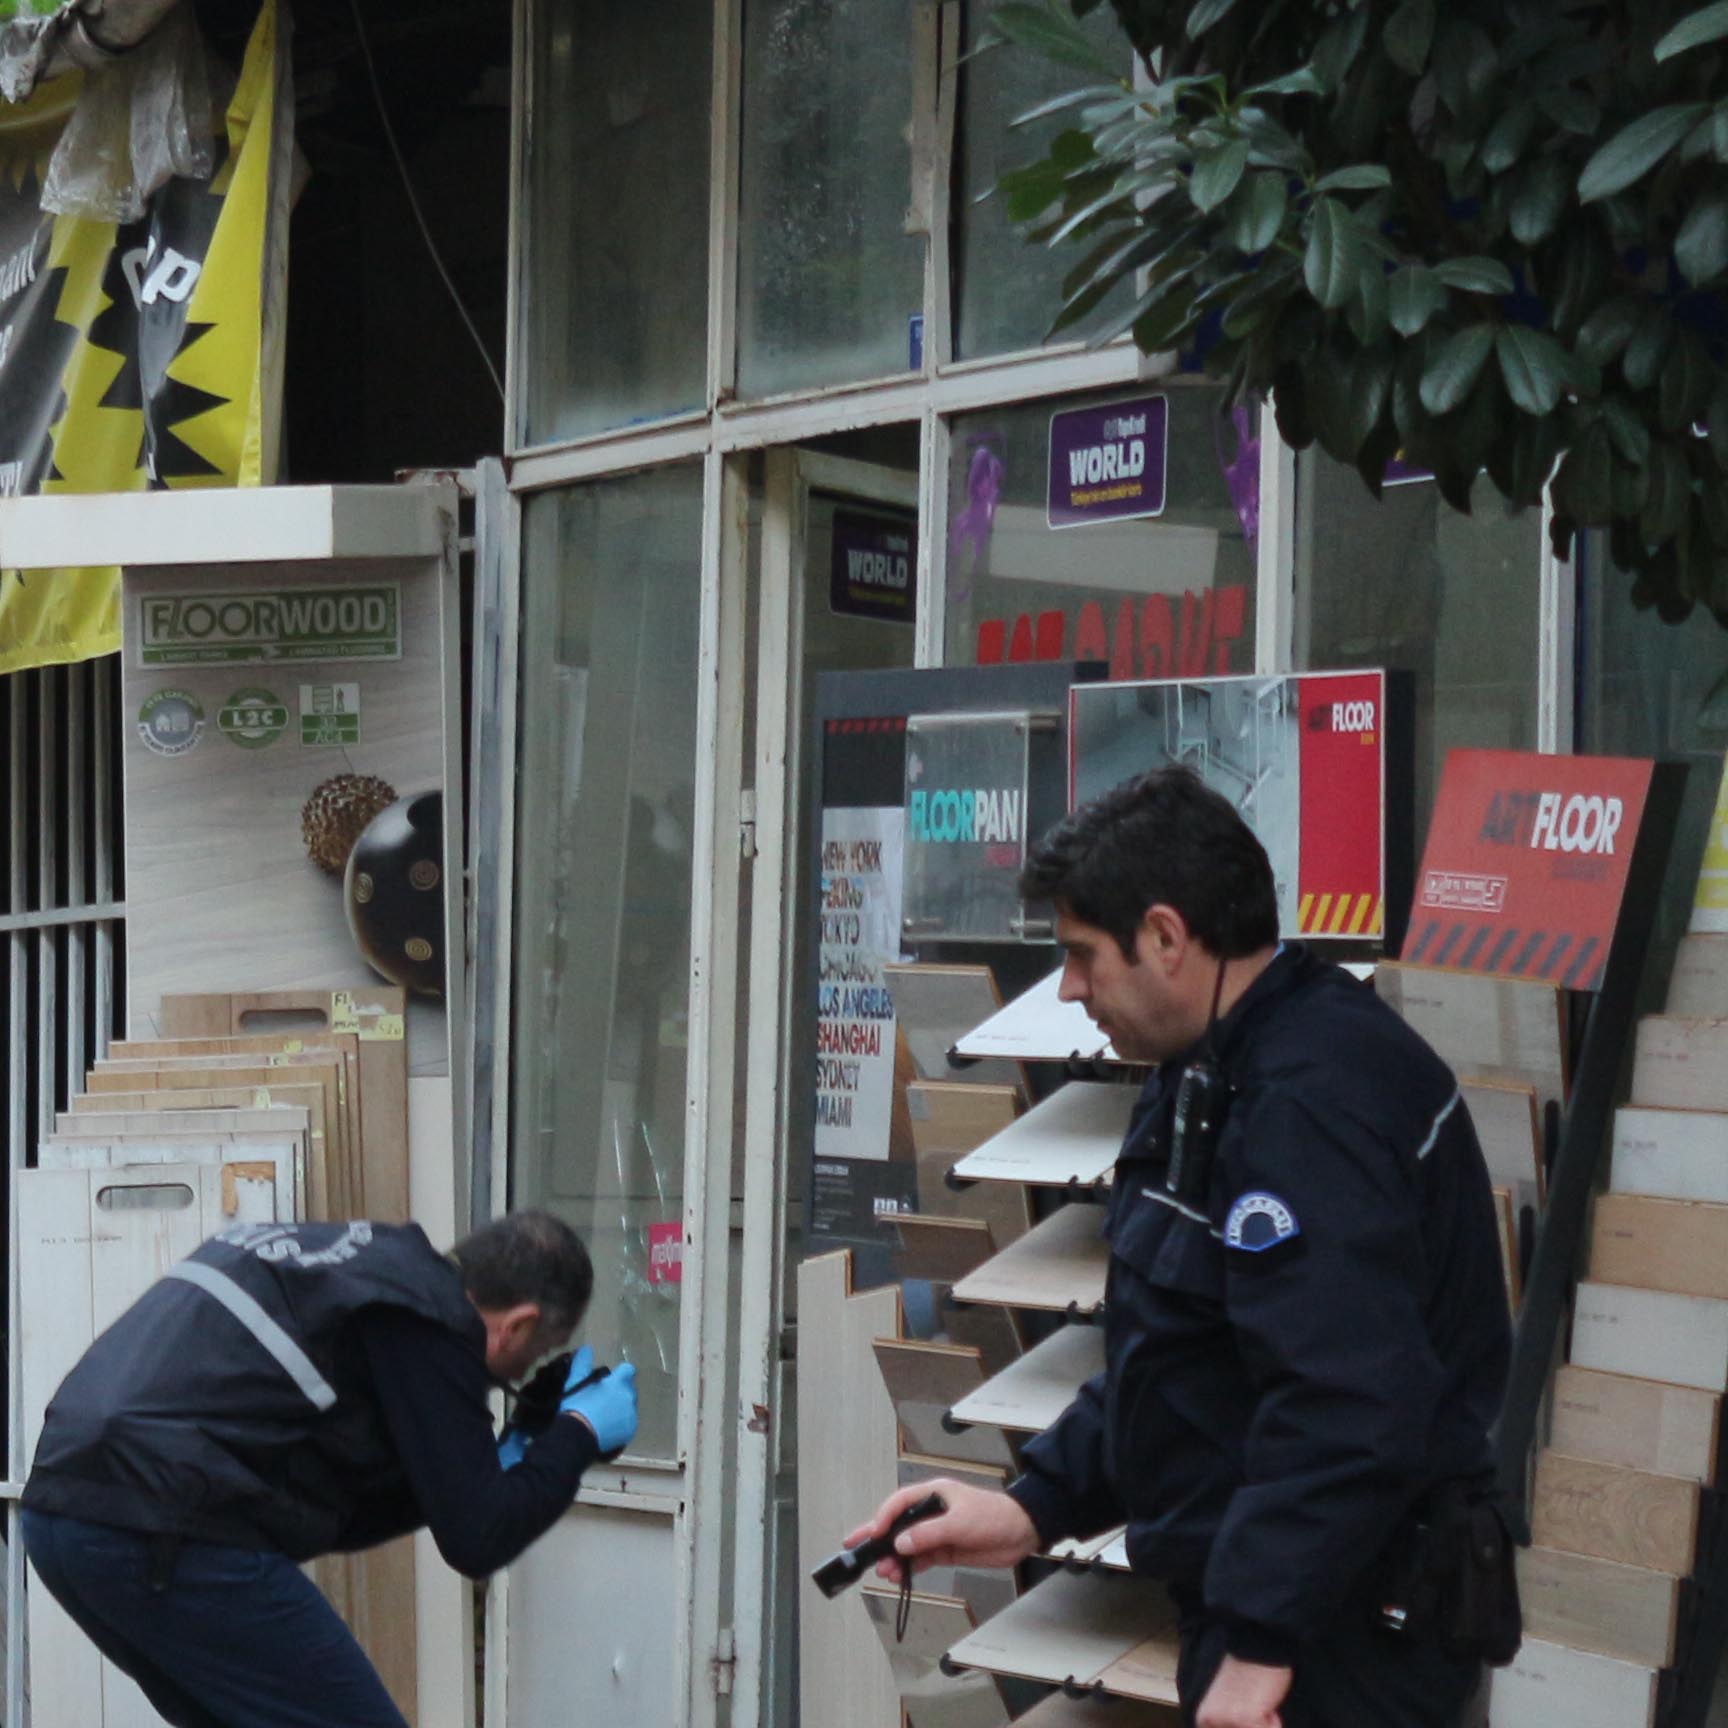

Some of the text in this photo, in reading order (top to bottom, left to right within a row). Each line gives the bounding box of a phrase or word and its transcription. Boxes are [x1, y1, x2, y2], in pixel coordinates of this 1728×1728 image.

[1069, 440, 1145, 486] WORLD
[848, 548, 907, 589] WORLD
[151, 594, 386, 638] FLOORWOOD
[911, 789, 1019, 841] FLOORPAN
[817, 1023, 881, 1057] SHANGHAI
